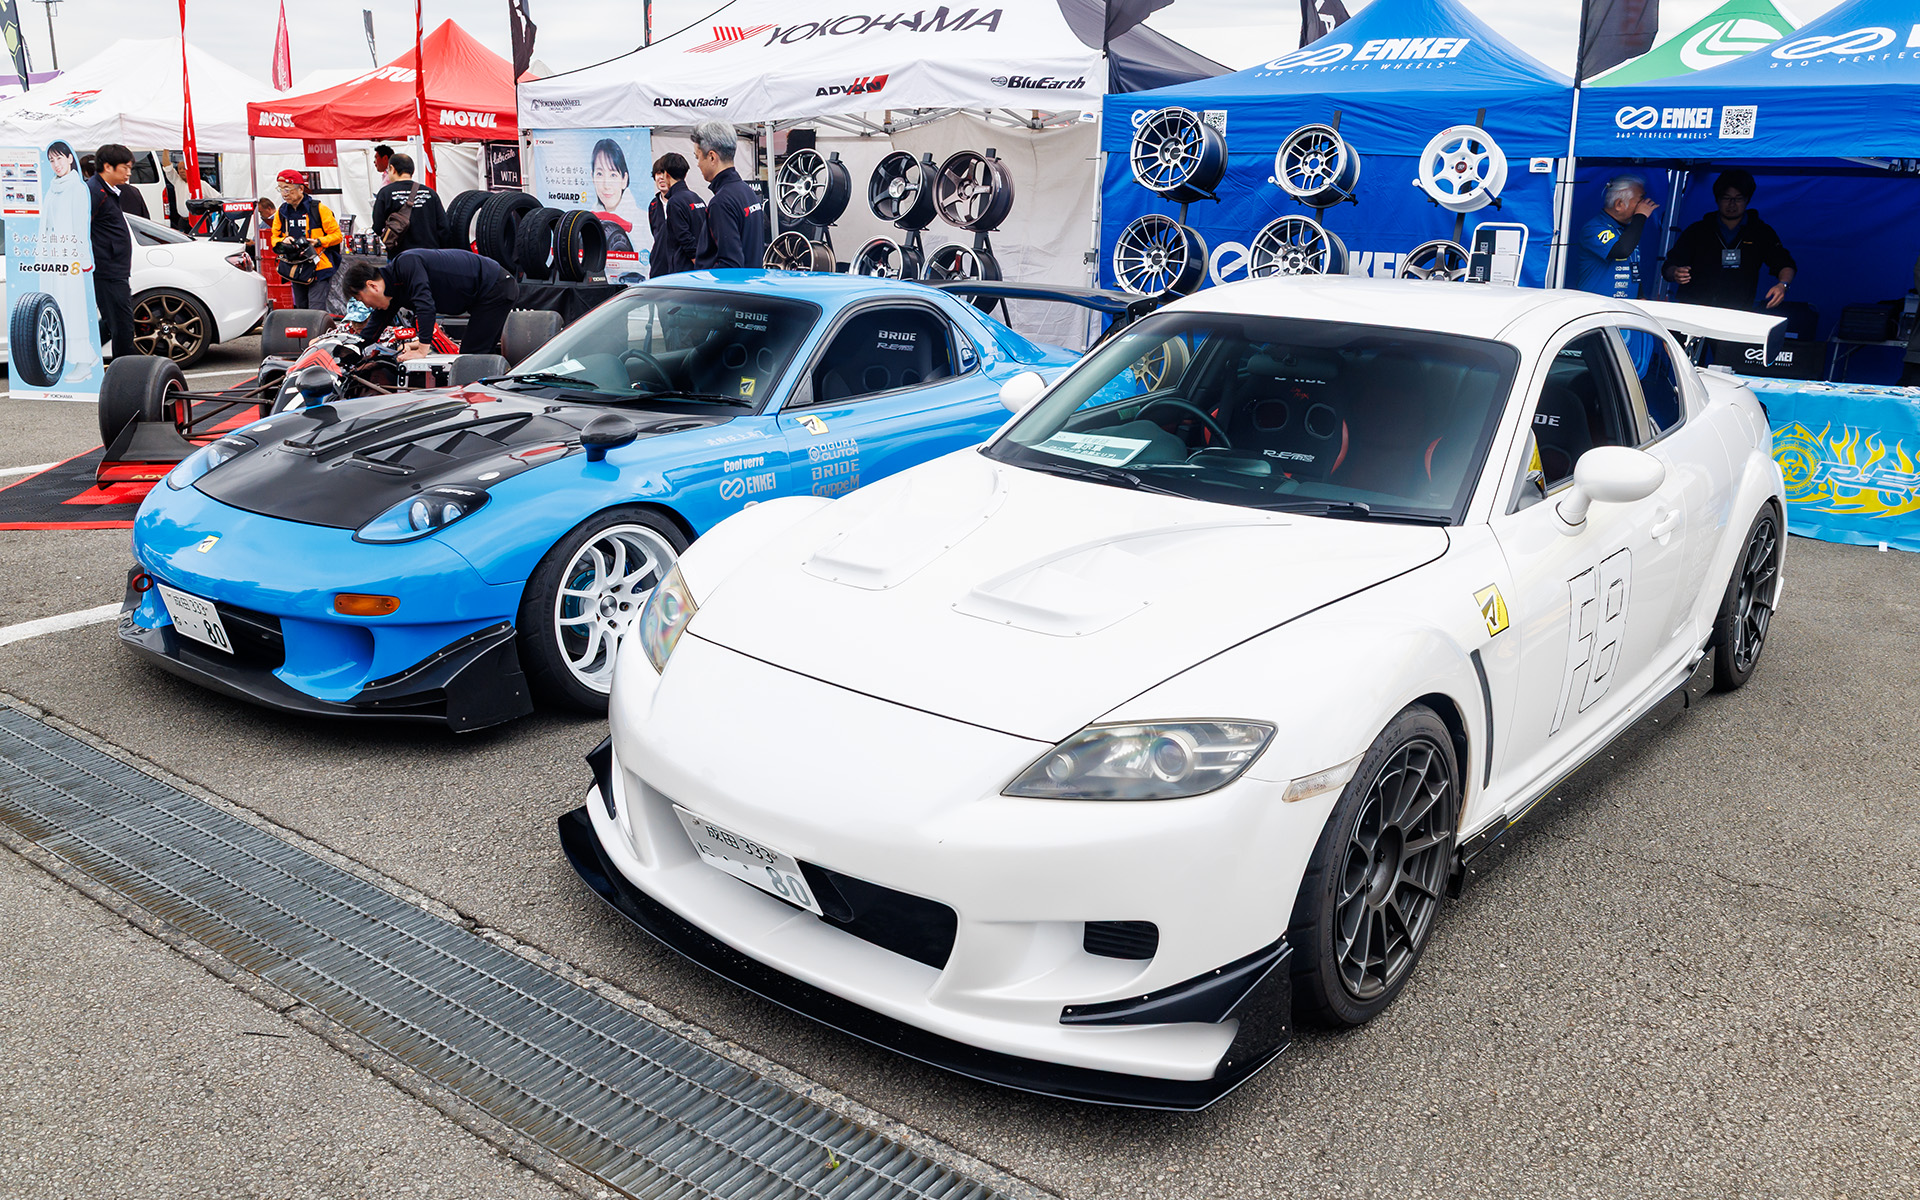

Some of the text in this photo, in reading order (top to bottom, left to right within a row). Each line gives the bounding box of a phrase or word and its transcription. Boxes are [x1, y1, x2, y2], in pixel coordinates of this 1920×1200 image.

[764, 6, 1003, 47] YOKOHAMA
[1352, 38, 1470, 61] ENKEI
[1301, 64, 1369, 75] PERFECT
[816, 80, 882, 97] ADVAN
[1007, 75, 1086, 90] BluEarth
[258, 111, 295, 127] MOTUL
[439, 109, 497, 128] MOTUL
[1661, 108, 1713, 129] ENKEI
[307, 144, 333, 154] MOTUL
[225, 203, 253, 211] MOTUL
[735, 311, 769, 321] BRIDE
[878, 330, 917, 341] BRIDE
[819, 438, 858, 452] OGURA
[821, 447, 859, 462] CLUTCH
[724, 456, 764, 473] Cool verre
[811, 459, 860, 480] BRIDE
[746, 472, 776, 494] ENKEI
[190, 600, 207, 617] 333
[203, 619, 228, 648] 80
[705, 824, 775, 864] 成田 333
[697, 840, 812, 907] に 80
